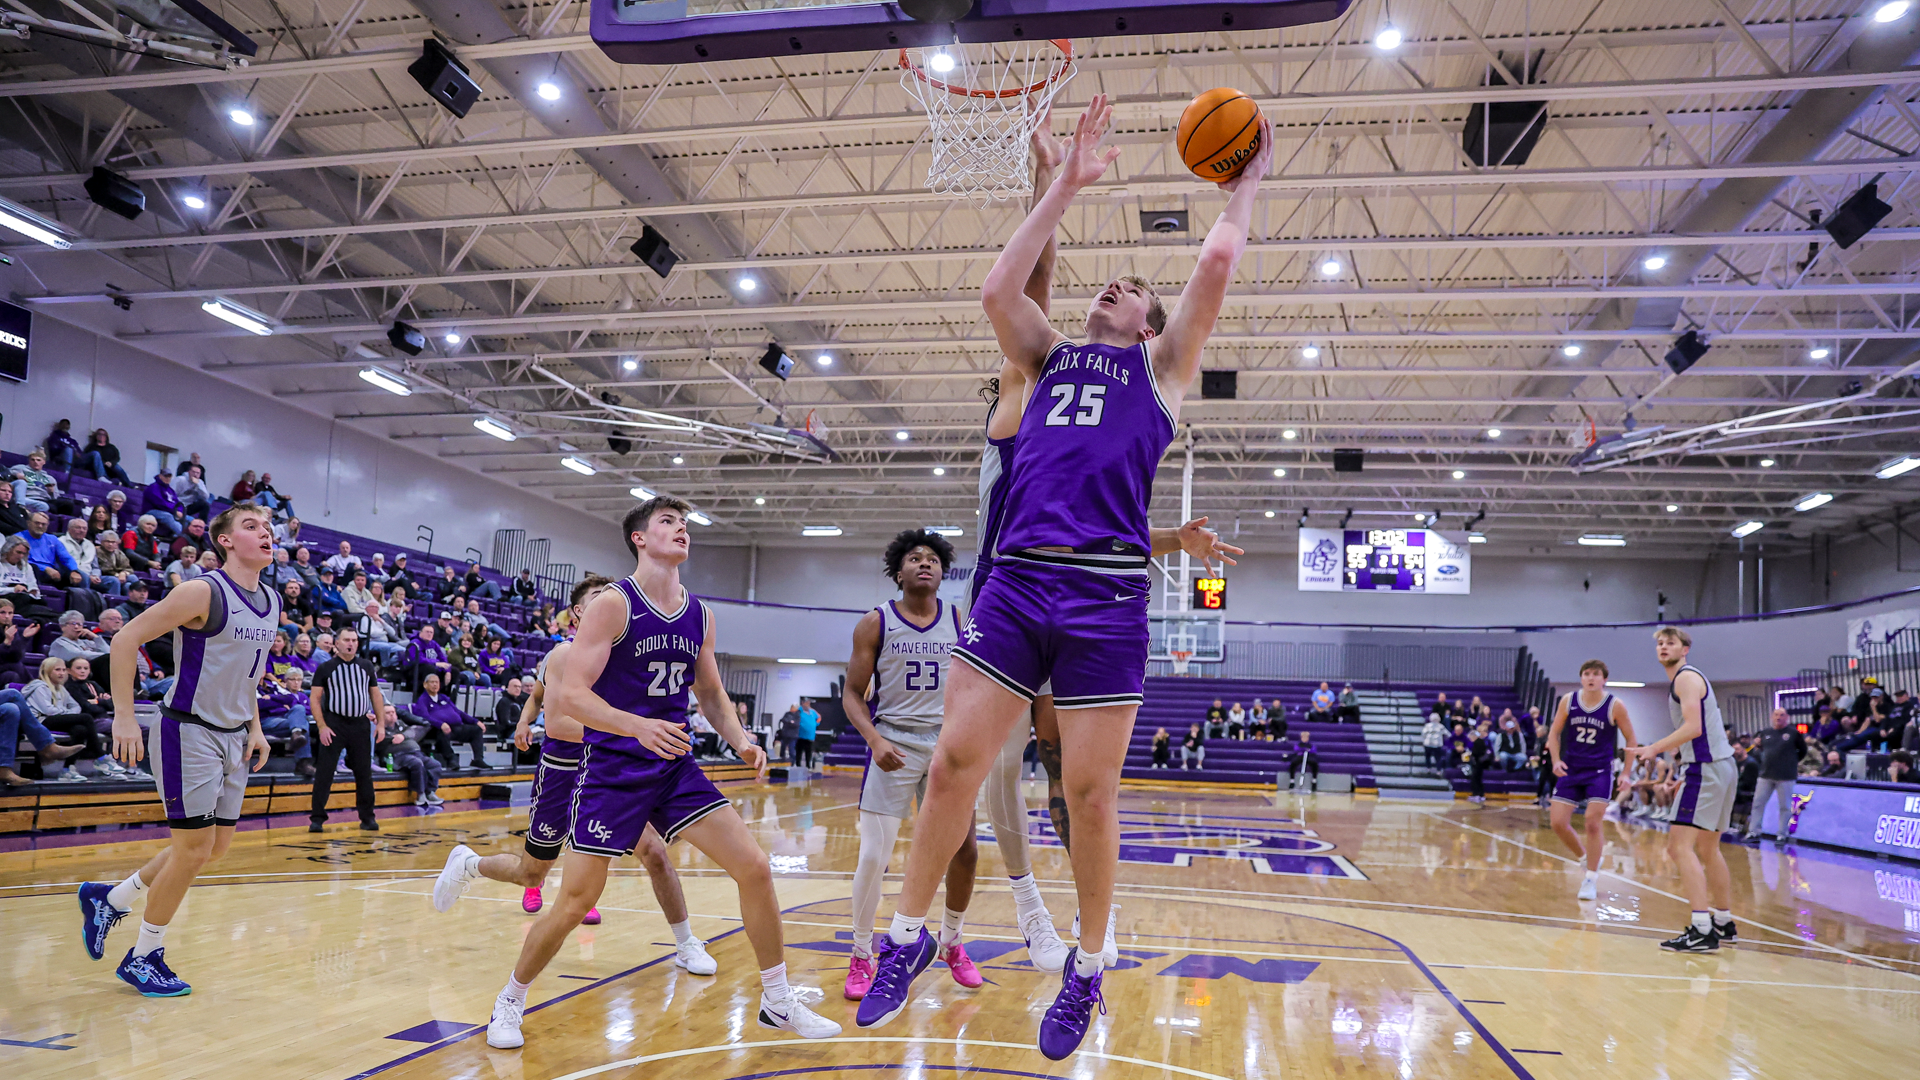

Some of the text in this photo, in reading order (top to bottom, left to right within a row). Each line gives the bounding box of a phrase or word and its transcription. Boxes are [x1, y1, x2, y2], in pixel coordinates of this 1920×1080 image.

[1086, 353, 1129, 386] FALLS
[1045, 383, 1107, 427] 25
[1369, 530, 1405, 546] 13:02
[1303, 552, 1338, 574] USF
[1347, 553, 1367, 569] 55
[1404, 553, 1424, 570] 54
[1197, 578, 1225, 591] 13:02
[1347, 572, 1357, 584] 7
[1414, 573, 1424, 586] 5
[1204, 590, 1221, 608] 15
[963, 617, 984, 645] USF
[635, 634, 668, 657] SIOUX
[891, 641, 952, 654] MAVERICKS
[247, 647, 263, 679] 1
[647, 660, 688, 697] 20
[905, 660, 940, 692] 23
[1576, 726, 1597, 745] 22
[538, 822, 558, 839] USF
[587, 819, 613, 843] USF
